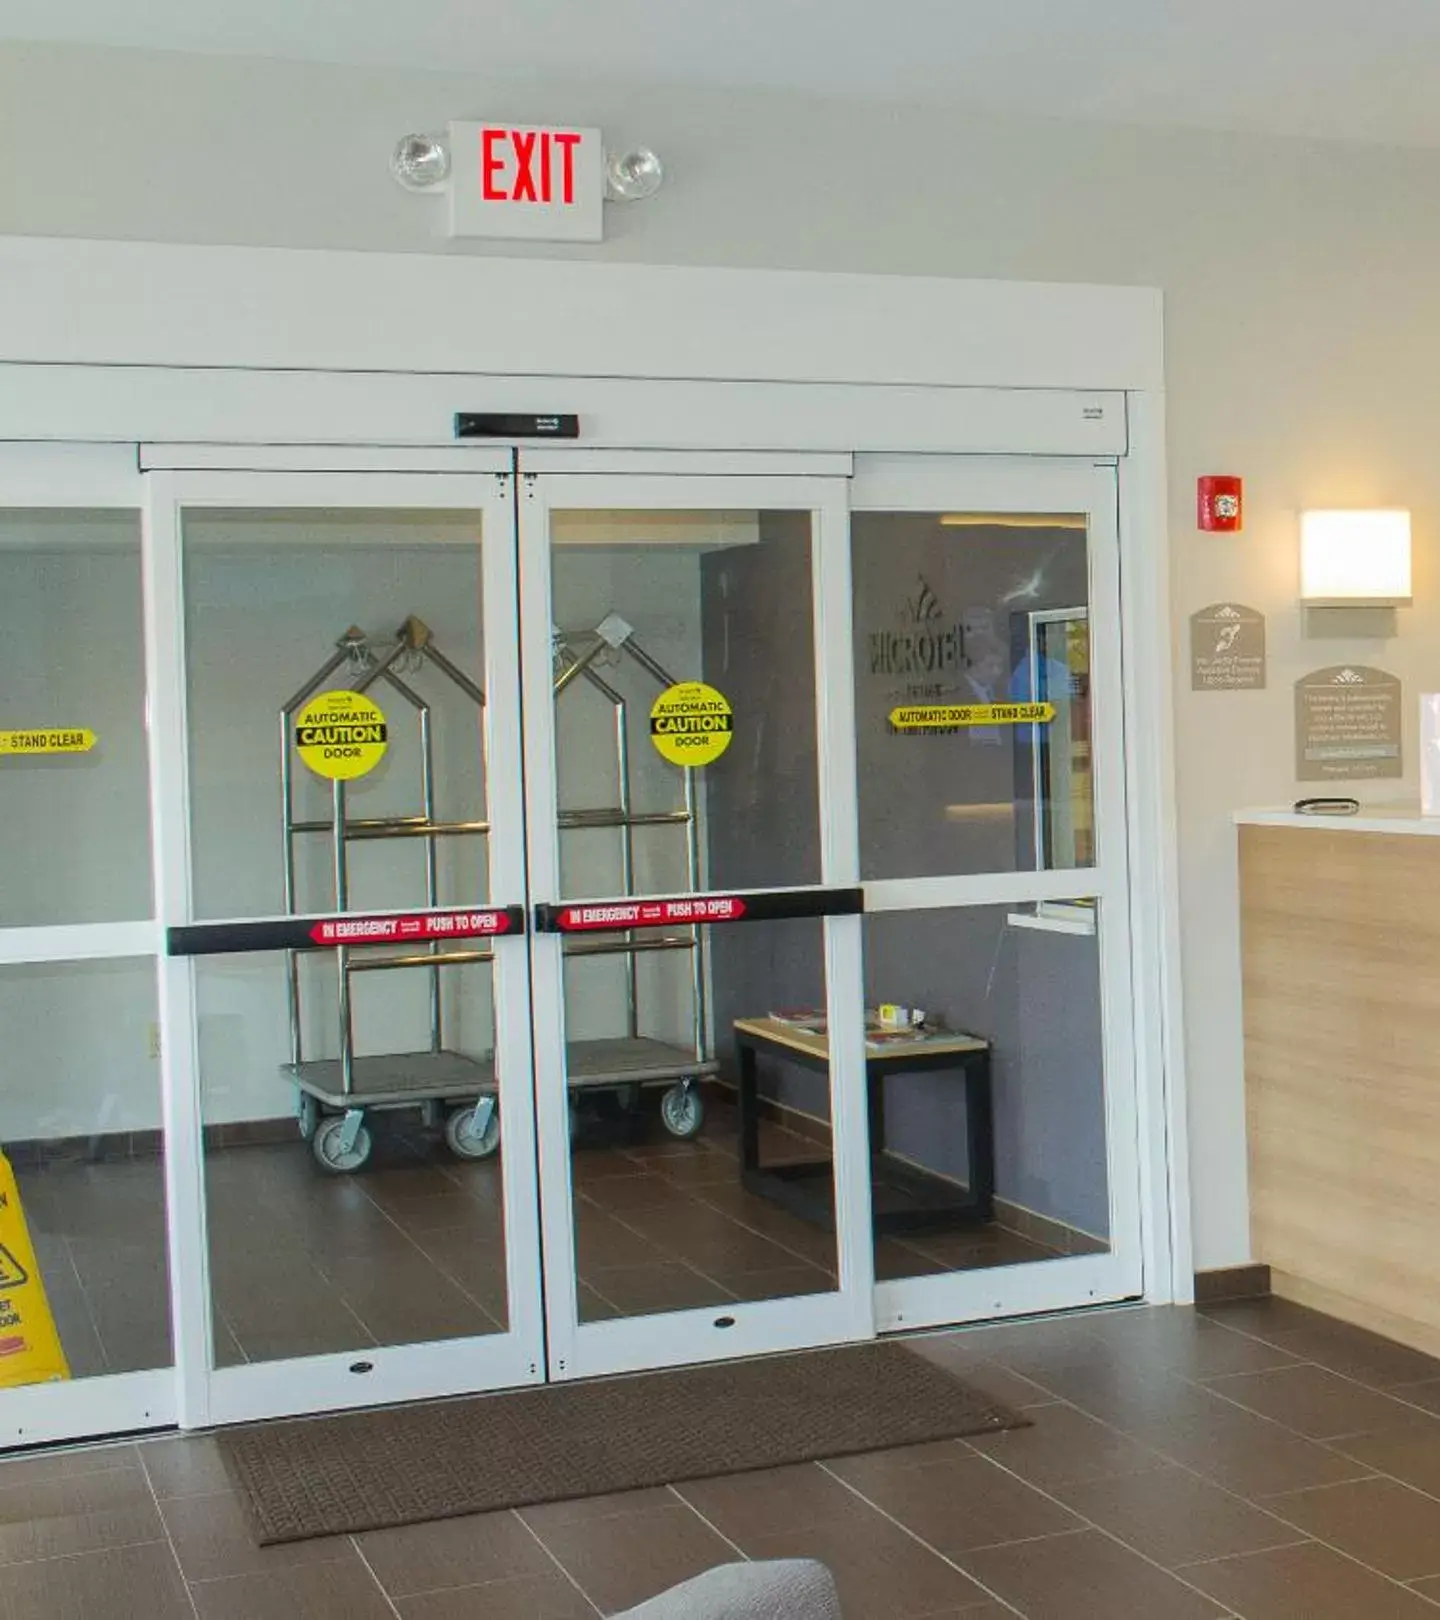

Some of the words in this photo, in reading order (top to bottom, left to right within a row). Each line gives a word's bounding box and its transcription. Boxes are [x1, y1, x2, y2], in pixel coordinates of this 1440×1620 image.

[482, 130, 581, 204] EXIT
[658, 702, 724, 713] AUTOMATIC
[898, 711, 946, 722] AUTOMATIC
[948, 709, 972, 721] DOOR
[305, 711, 377, 724] AUTOMATIC
[655, 715, 728, 733] CAUTION
[10, 734, 47, 748] STAND
[49, 732, 84, 747] CLEAR
[301, 725, 381, 744] CAUTION
[674, 736, 709, 747] DOOR
[324, 747, 362, 759] DOOR
[570, 910, 581, 924] IN
[583, 906, 640, 923] EMERGENCY
[666, 902, 692, 916] PUSH
[694, 901, 707, 914] TO
[707, 899, 733, 914] OPEN
[323, 923, 334, 938] IN
[336, 920, 398, 937] EMERGENCY
[426, 917, 453, 931] PUSH
[455, 916, 470, 929] TO
[472, 913, 498, 929] OPEN
